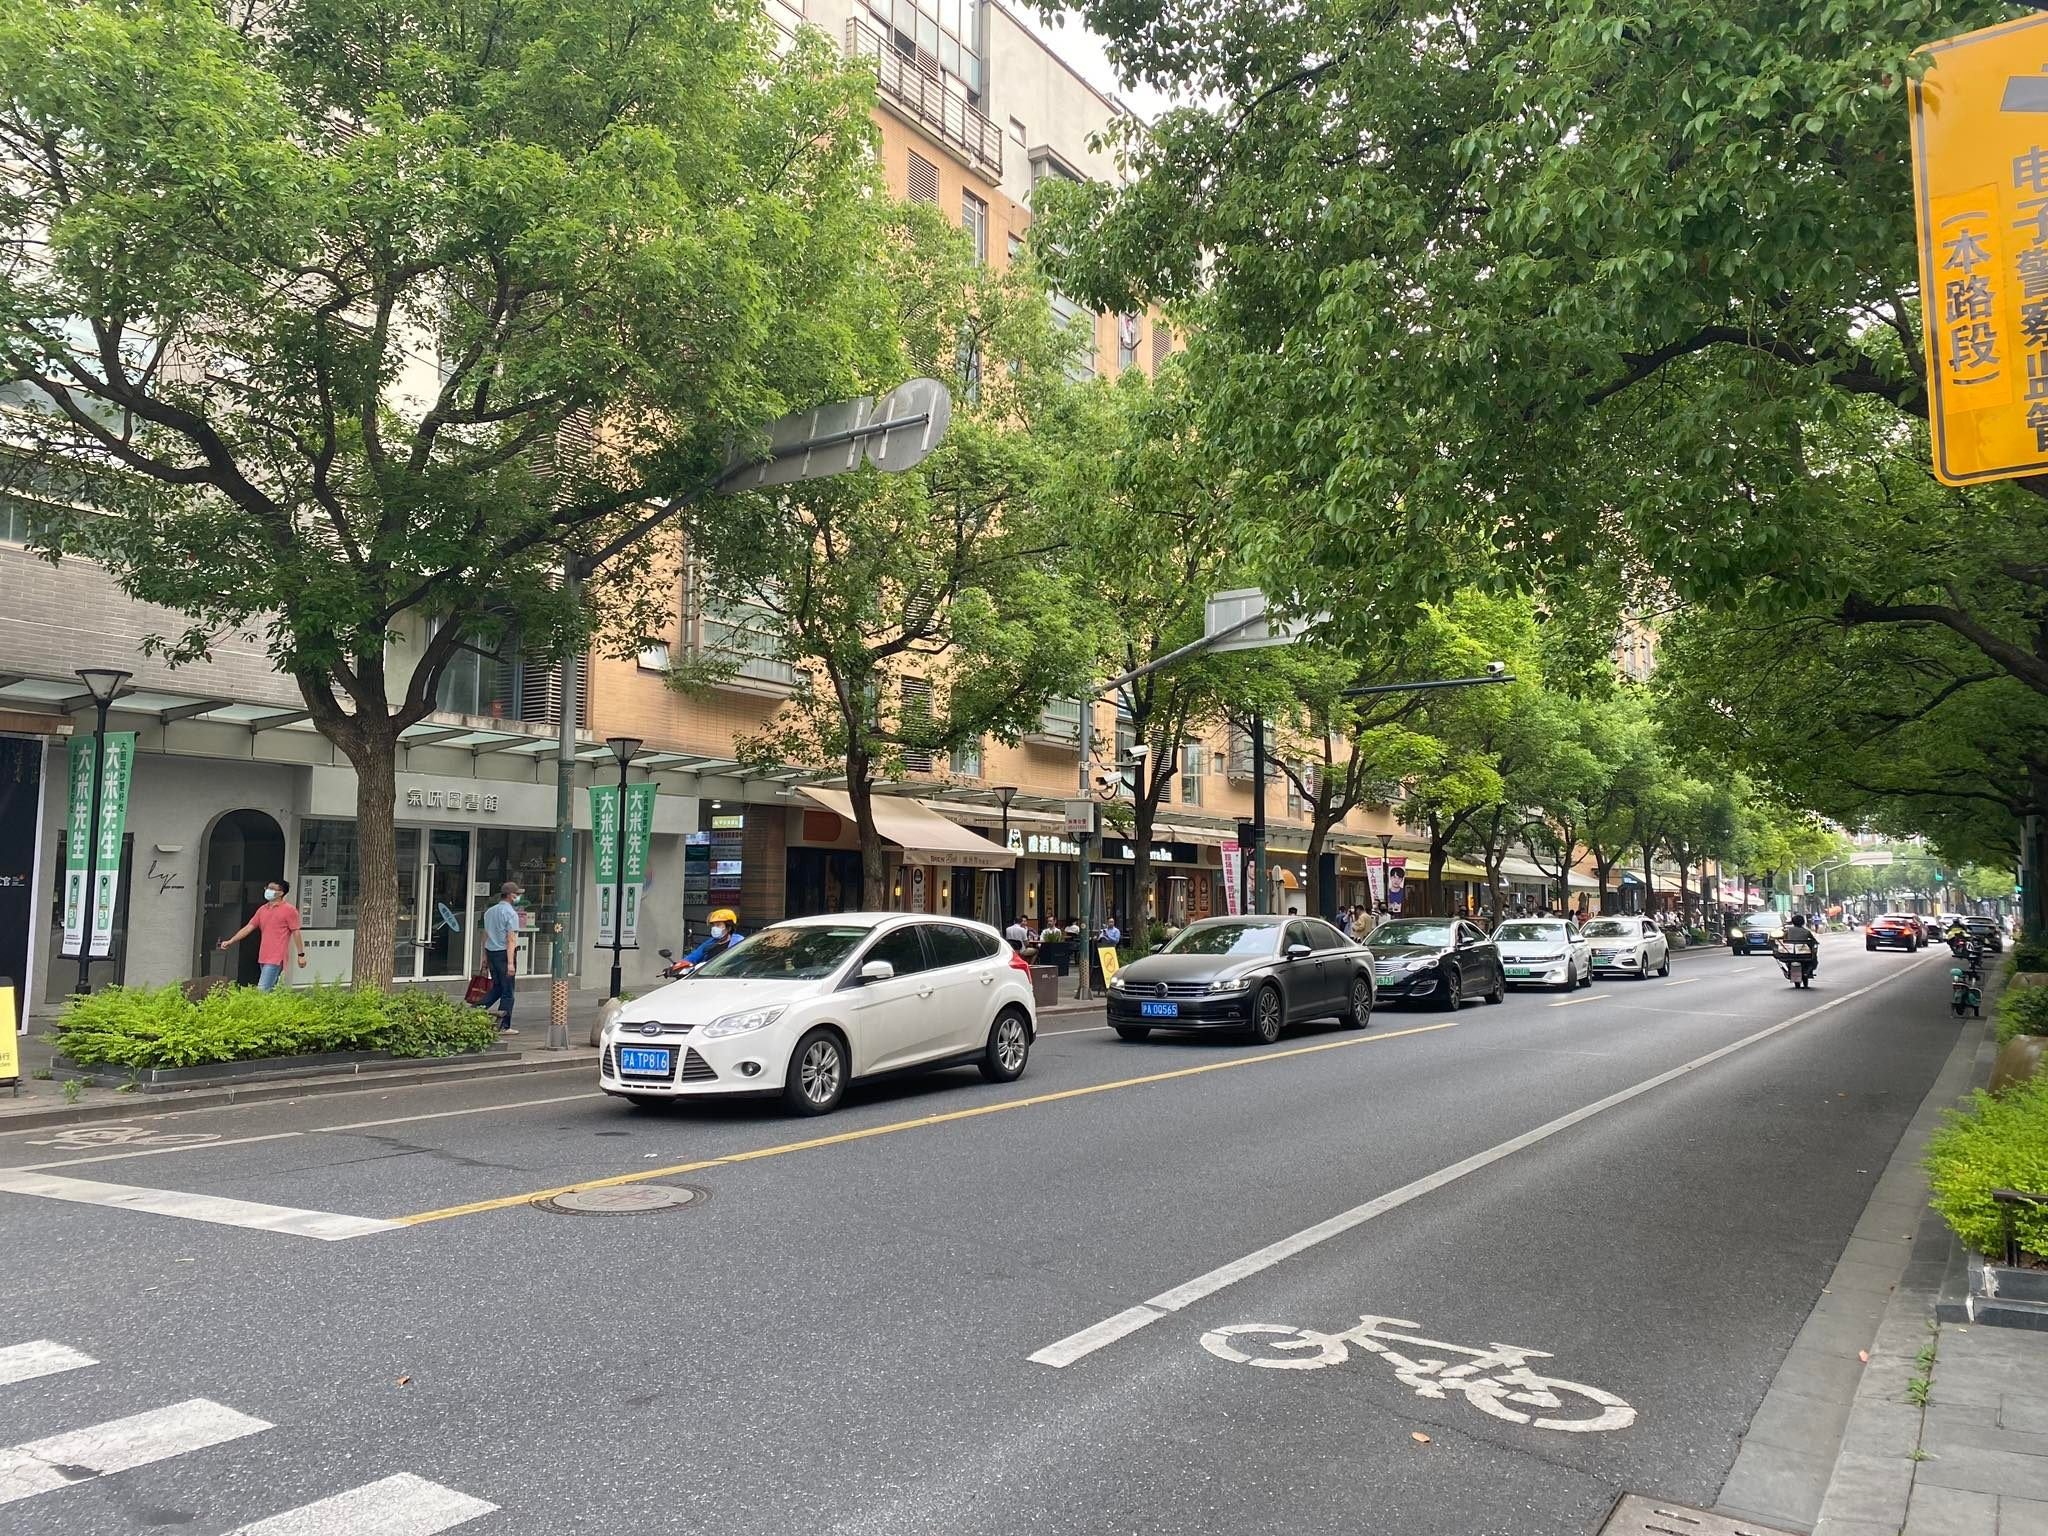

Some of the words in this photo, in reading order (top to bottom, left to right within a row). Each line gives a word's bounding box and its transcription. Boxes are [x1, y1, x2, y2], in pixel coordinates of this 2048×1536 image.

[1941, 211, 2001, 386] （本路段）
[72, 743, 92, 859] 大米先生
[100, 741, 120, 859] 大米先生
[600, 791, 614, 876] 大米先生
[627, 790, 643, 876] 大米先生
[321, 878, 329, 908] WATER
